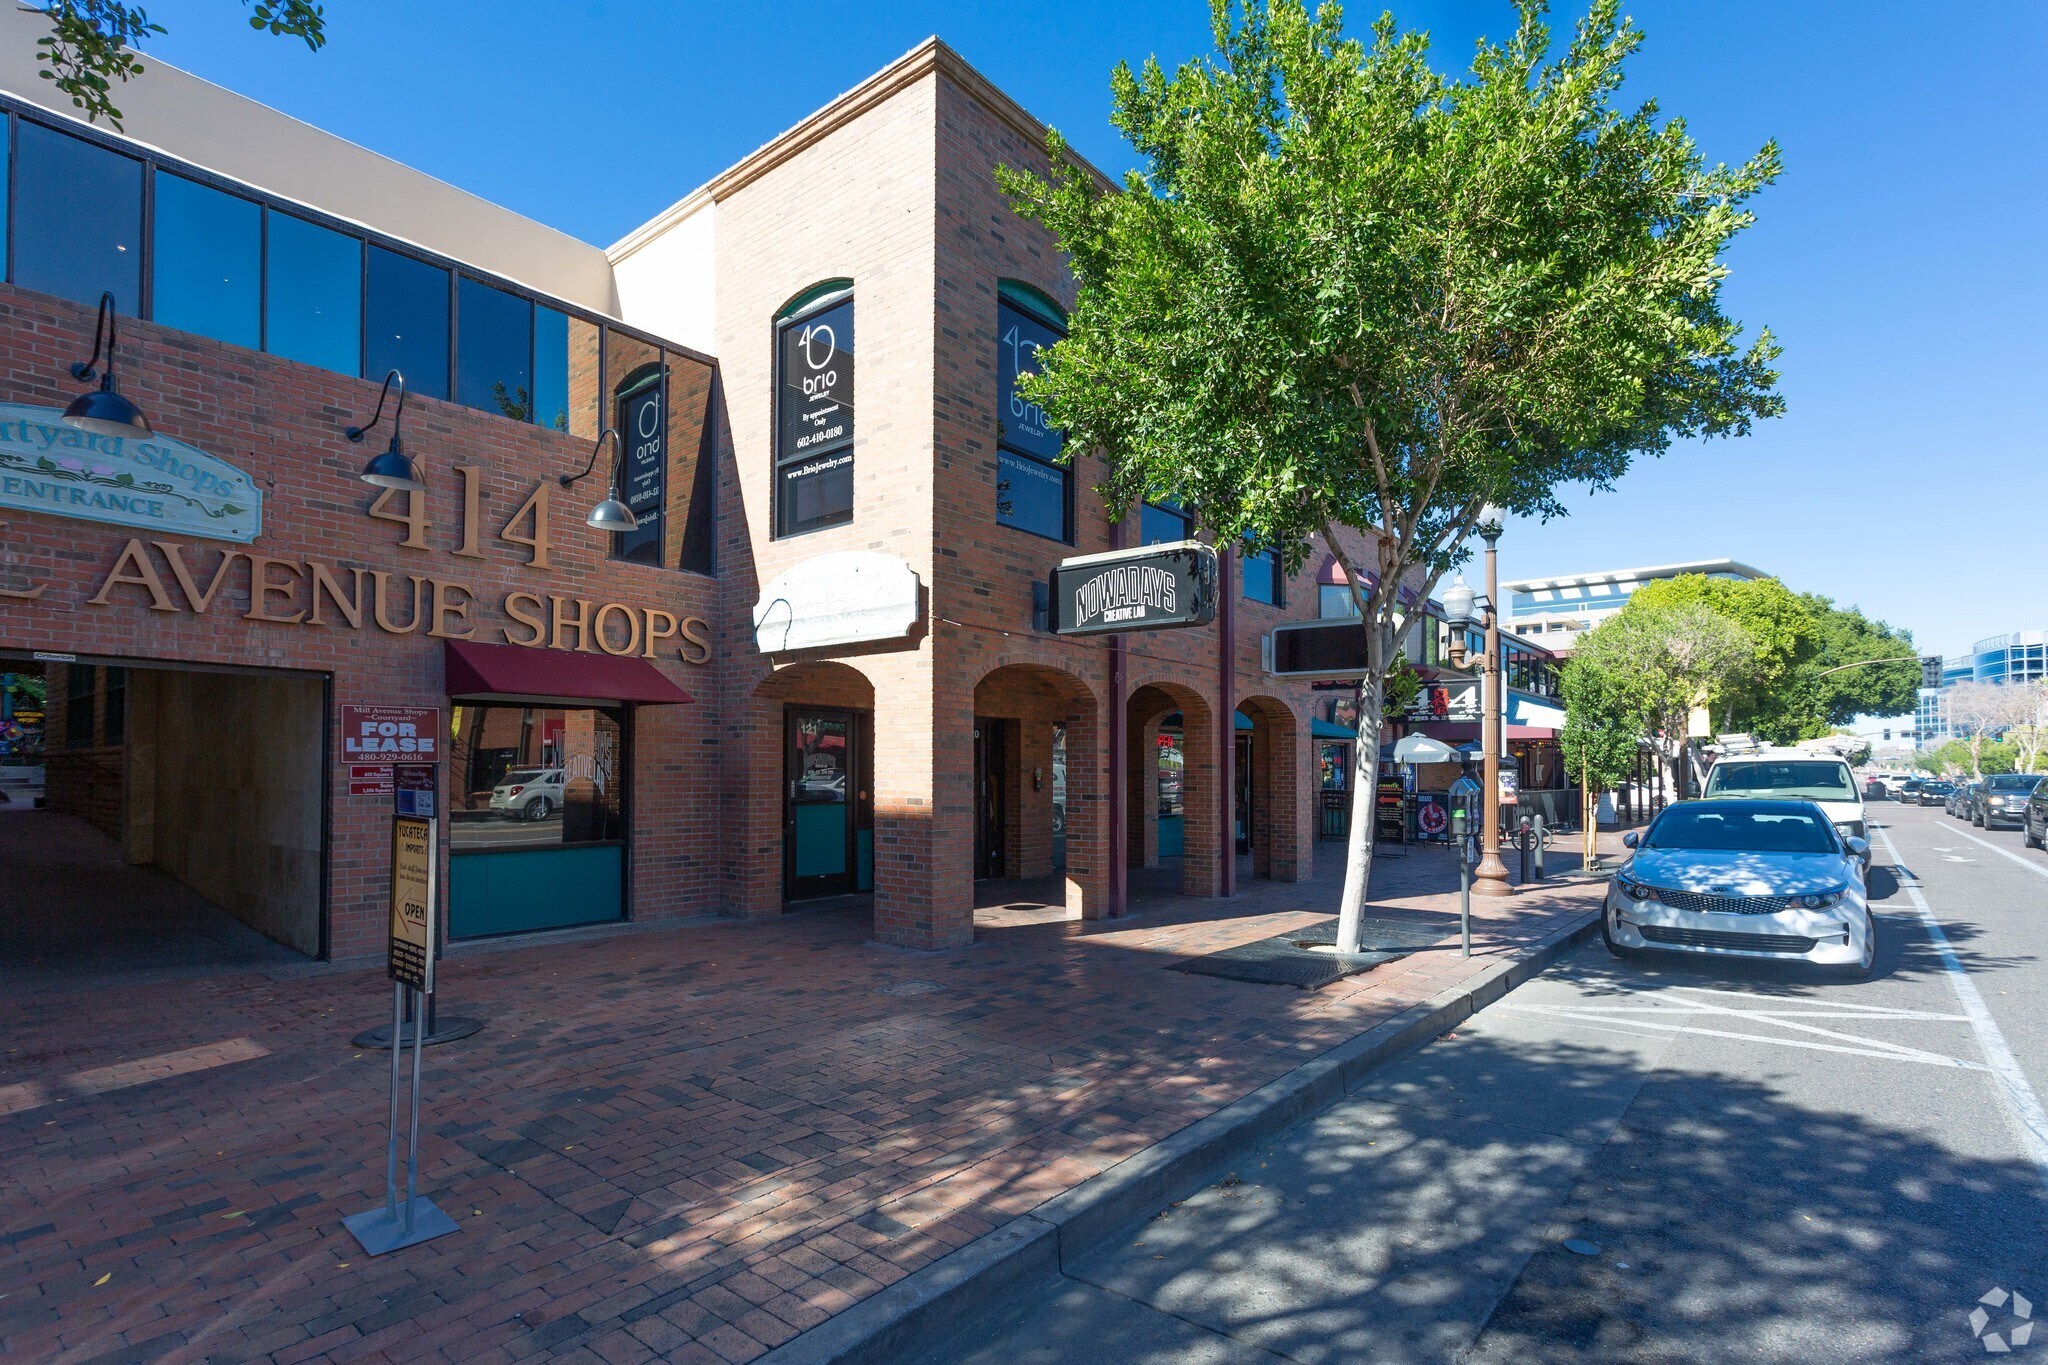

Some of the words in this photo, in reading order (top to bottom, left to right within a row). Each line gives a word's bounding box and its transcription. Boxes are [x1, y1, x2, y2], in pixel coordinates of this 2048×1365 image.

[803, 370, 837, 395] brio
[802, 413, 809, 422] By
[809, 404, 839, 420] appointment
[814, 417, 827, 426] Only
[797, 425, 843, 448] 602-410-0180
[1017, 422, 1045, 439] JEWELRY
[134, 442, 237, 498] Shops
[787, 455, 852, 479] www.BrioJewelry.com
[2, 475, 165, 518] ENTRANCE
[369, 453, 555, 571] 414
[86, 538, 478, 641] AVENUE
[501, 591, 712, 664] SHOPS
[1075, 566, 1176, 628] NOWADAYS
[1103, 606, 1133, 623] CREATIVE
[1133, 605, 1146, 618] LAB
[404, 708, 428, 716] Shops
[361, 721, 417, 737] FOR
[801, 724, 818, 735] 121
[346, 738, 435, 752] LEASE
[358, 753, 423, 761] 480-929-0616
[398, 825, 428, 842] YUCATECA
[404, 902, 424, 920] OPEN
